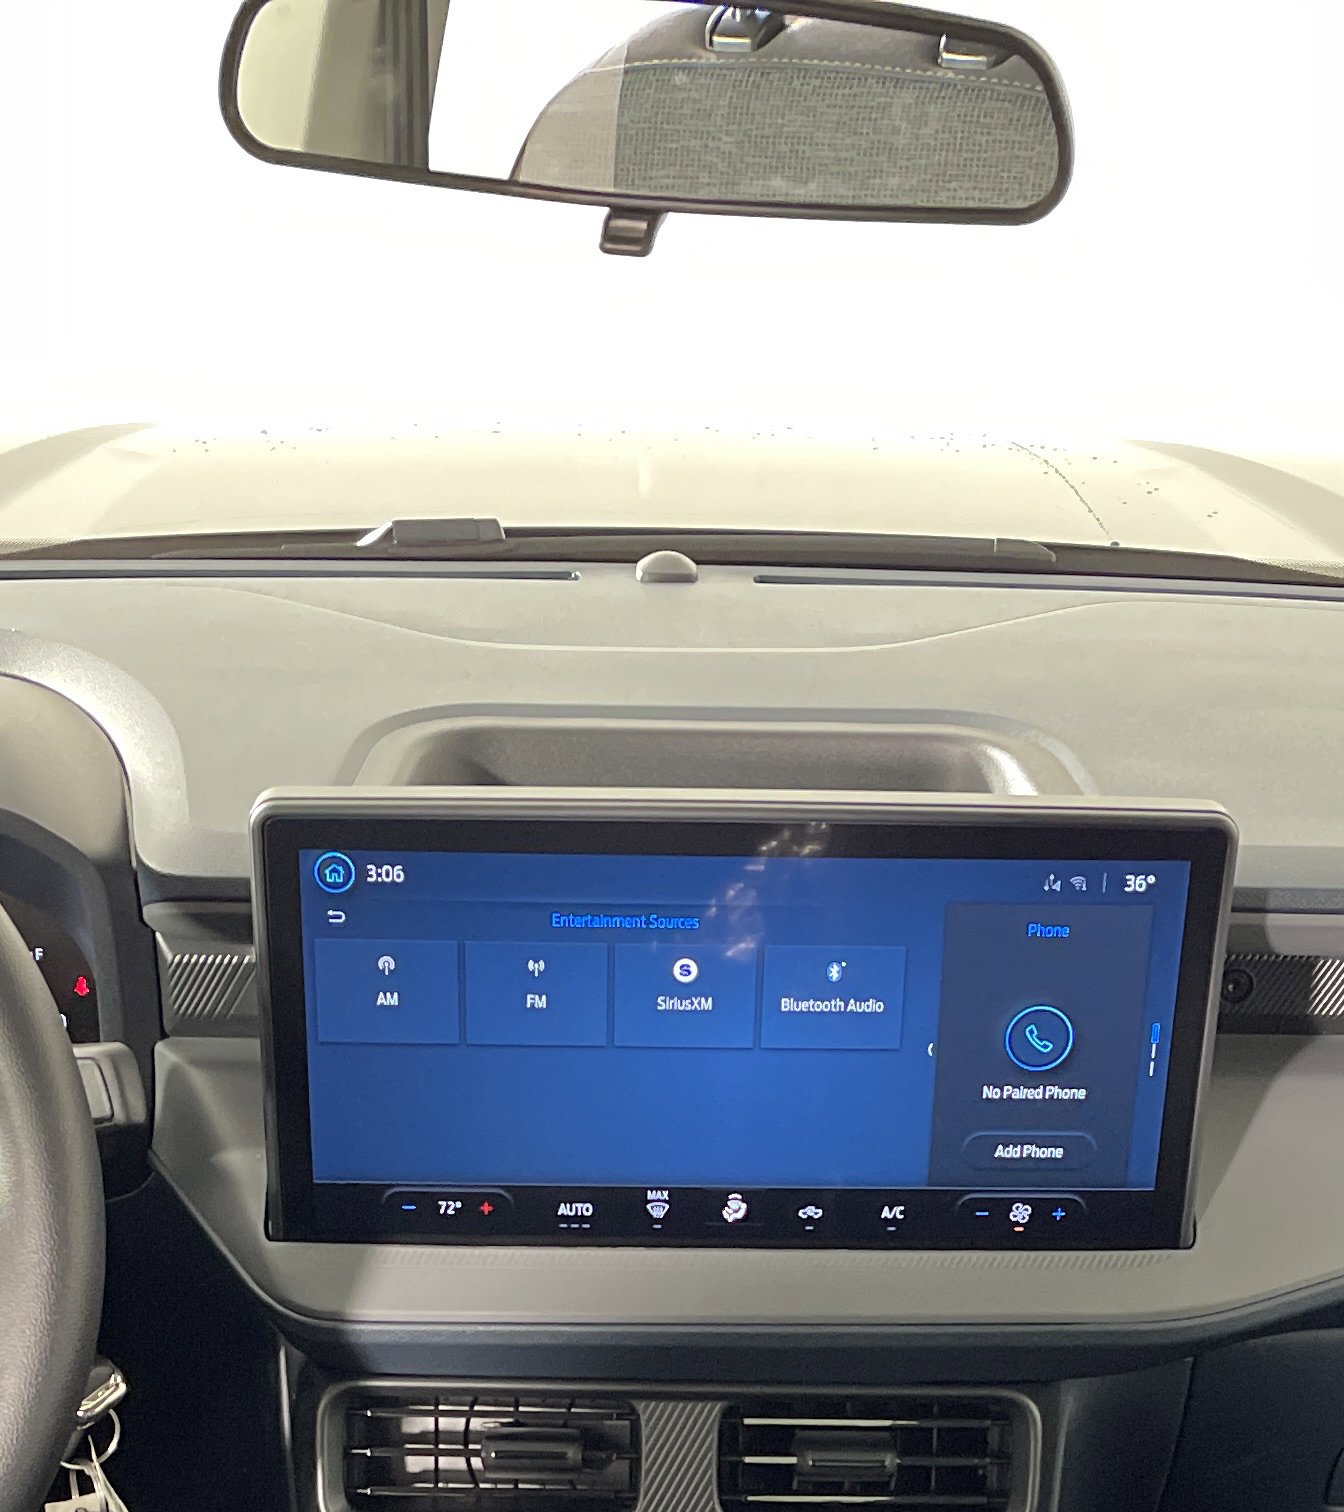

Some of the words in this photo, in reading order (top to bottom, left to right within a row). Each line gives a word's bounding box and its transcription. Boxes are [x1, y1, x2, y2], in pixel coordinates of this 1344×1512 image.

[366, 864, 405, 883] 3:06
[1123, 874, 1156, 893] 36°
[551, 912, 647, 929] Entertainment
[649, 914, 700, 930] Sources
[1027, 923, 1071, 938] Phone
[35, 947, 44, 960] F
[376, 991, 399, 1006] AM
[526, 994, 547, 1009] FM
[656, 995, 713, 1012] SiriusXM
[780, 997, 845, 1013] Bluetooth
[846, 998, 884, 1013] Audio
[982, 1085, 1001, 1099] No
[1003, 1085, 1043, 1099] Paired
[1045, 1085, 1087, 1099] Phone
[994, 1144, 1020, 1158] Add
[1022, 1144, 1064, 1159] Phone
[646, 1189, 670, 1201] MAX
[437, 1200, 463, 1215] 72°
[557, 1202, 594, 1217] AUTO
[881, 1205, 905, 1220] A/C
